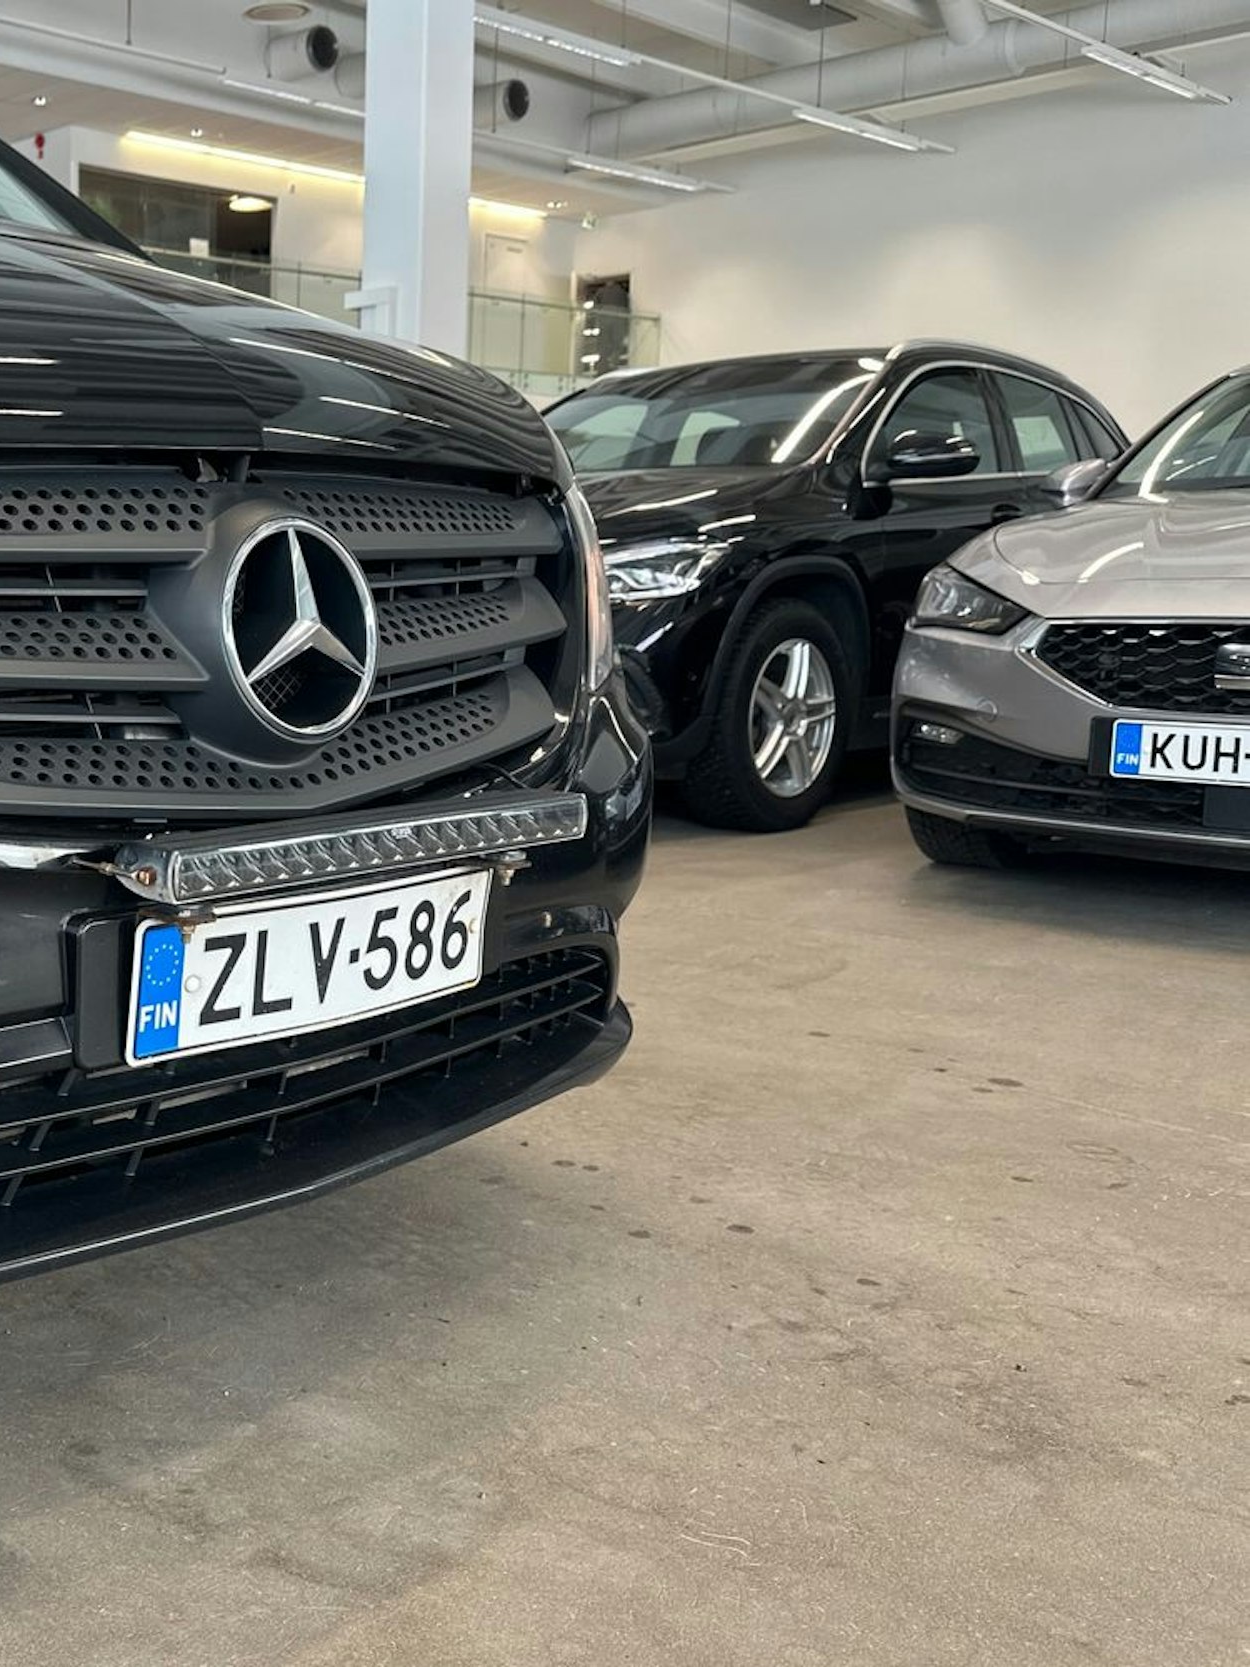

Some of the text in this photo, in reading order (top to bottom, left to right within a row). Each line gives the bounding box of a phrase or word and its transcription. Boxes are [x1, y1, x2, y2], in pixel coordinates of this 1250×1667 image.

[1116, 752, 1139, 766] FIN
[198, 889, 472, 1027] ZLV-586
[138, 1000, 178, 1033] FIN
